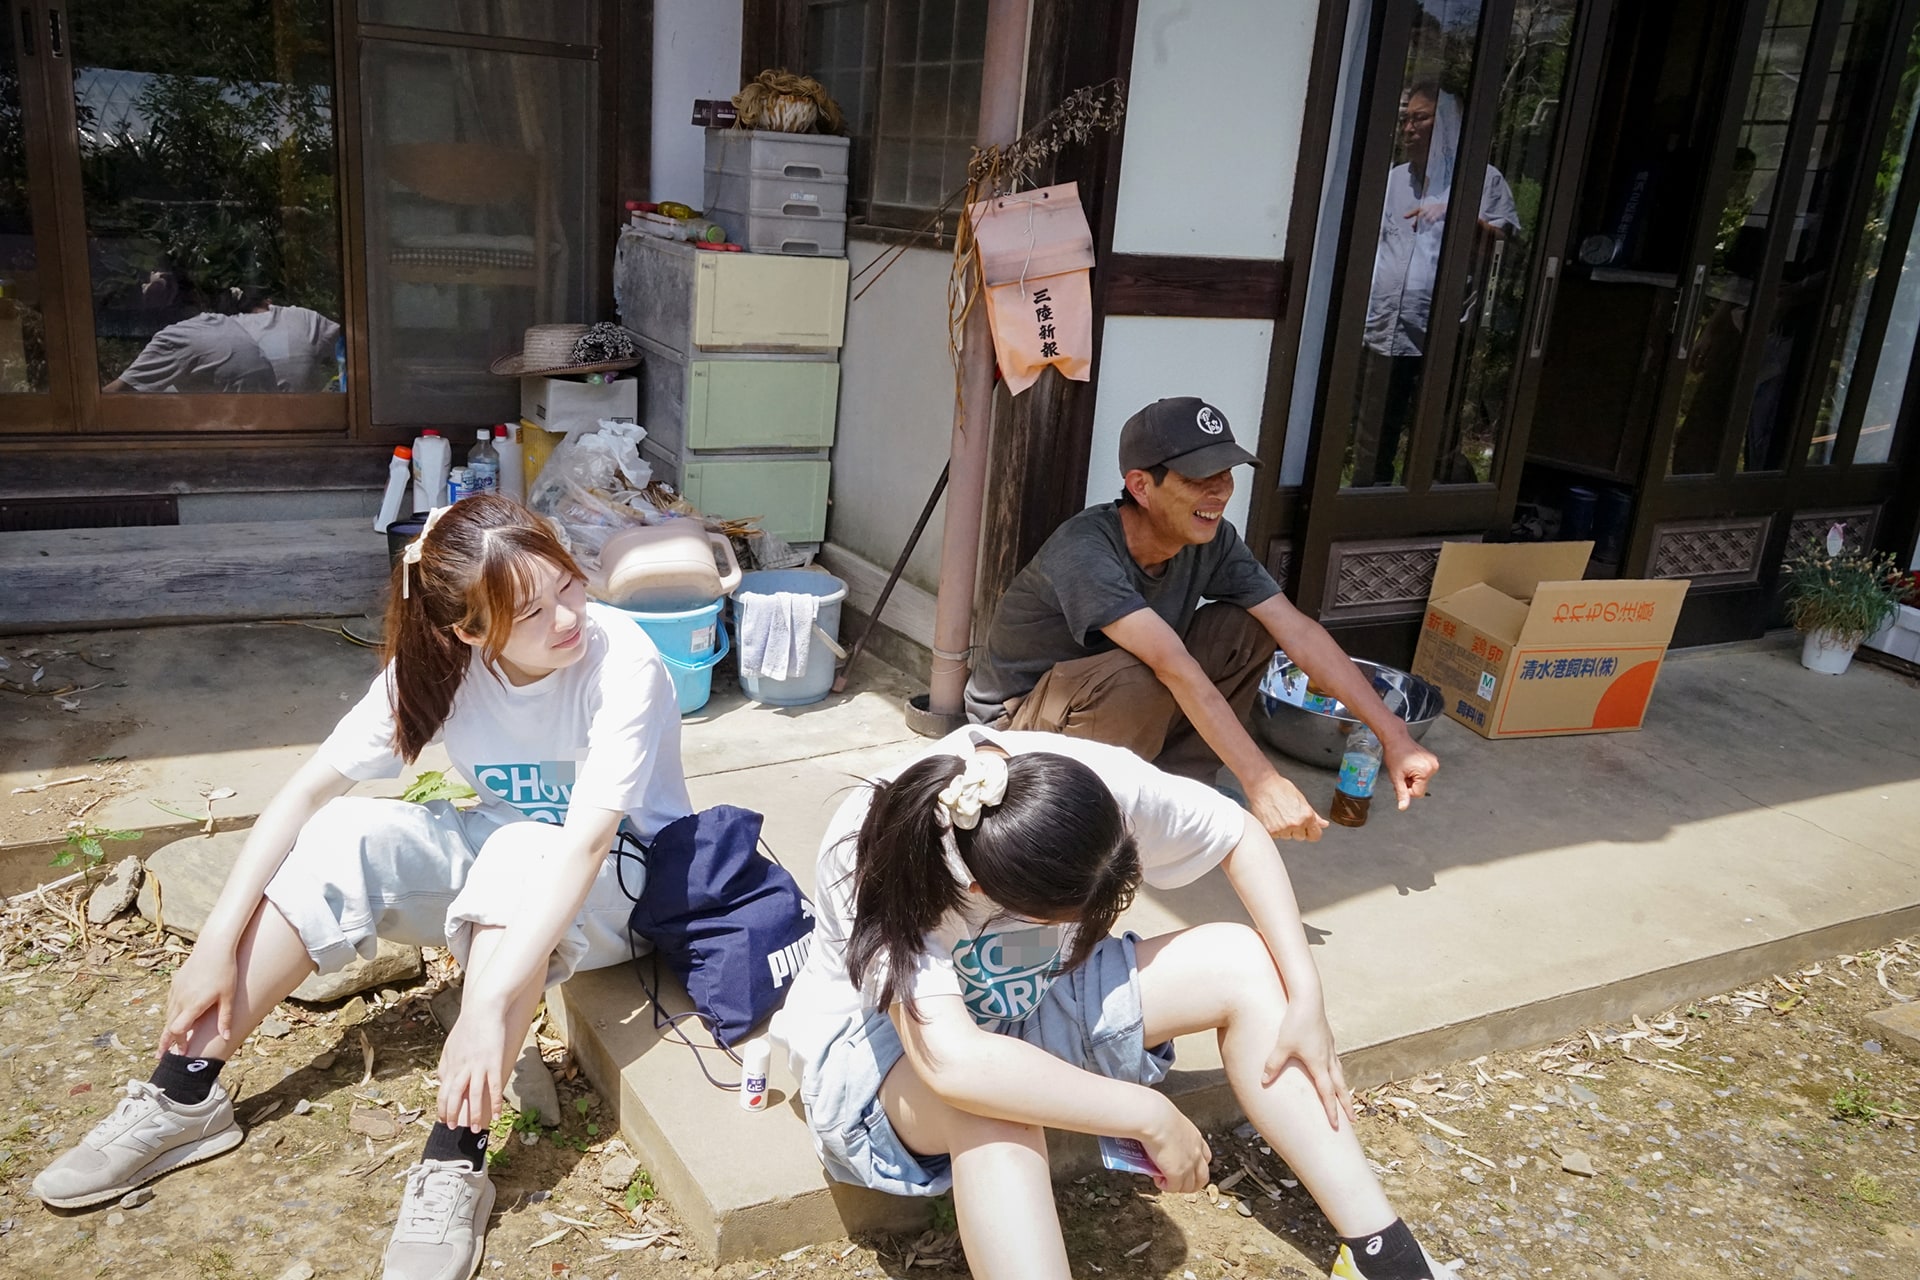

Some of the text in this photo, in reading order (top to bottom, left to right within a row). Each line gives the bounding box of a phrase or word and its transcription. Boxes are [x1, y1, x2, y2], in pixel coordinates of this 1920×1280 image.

[1033, 288, 1060, 358] 三陸新報
[1553, 601, 1655, 623] われもの注意
[1482, 674, 1493, 689] M
